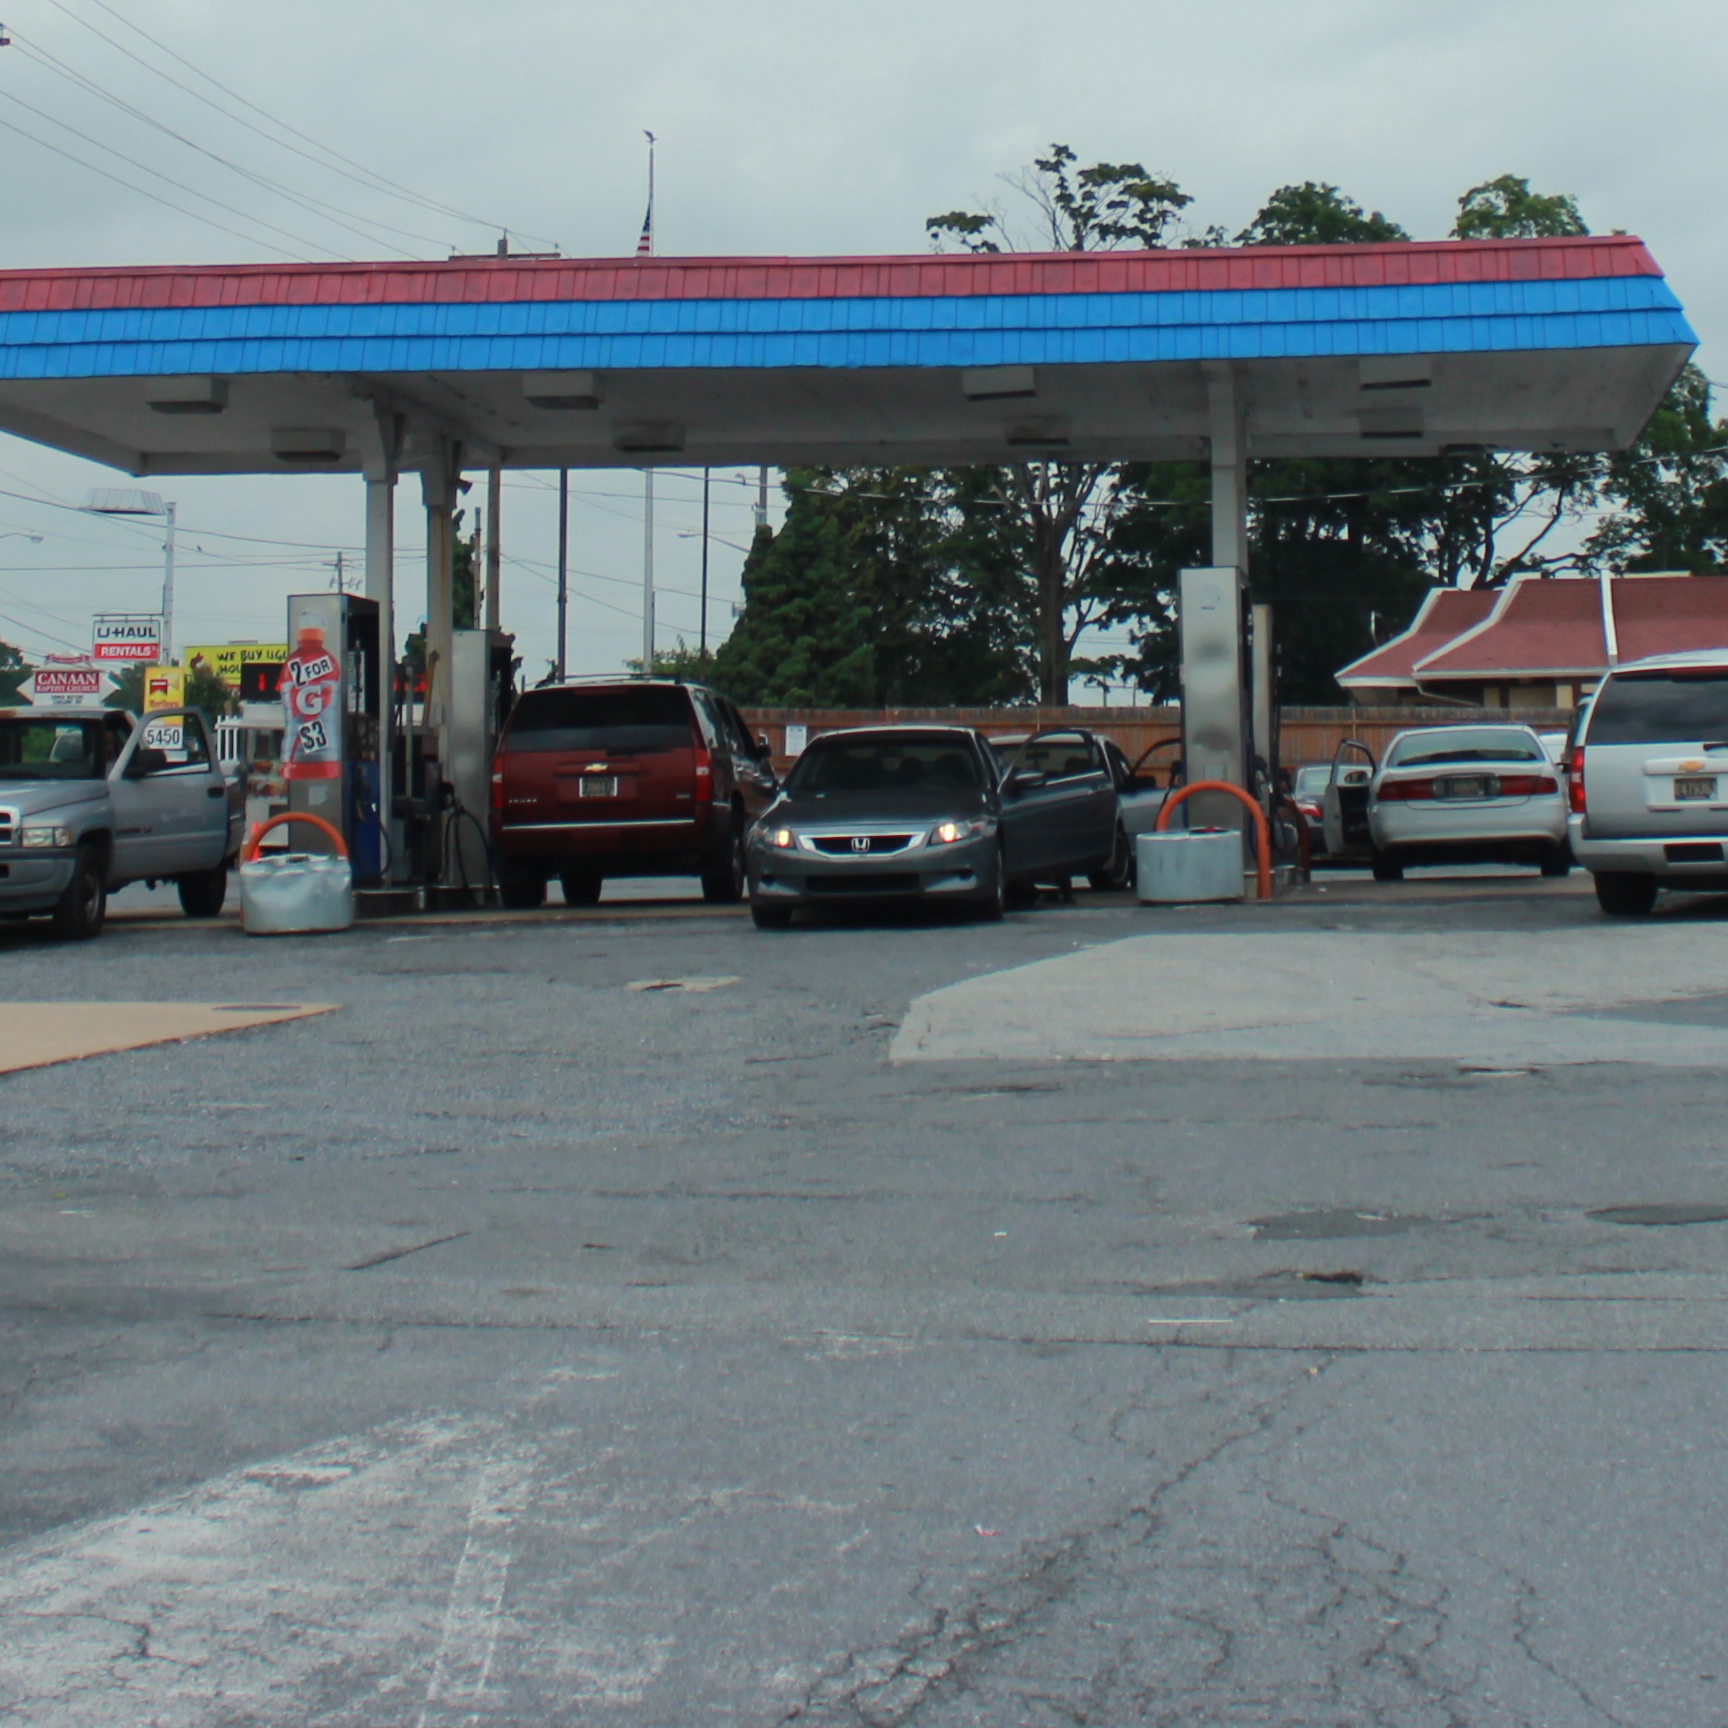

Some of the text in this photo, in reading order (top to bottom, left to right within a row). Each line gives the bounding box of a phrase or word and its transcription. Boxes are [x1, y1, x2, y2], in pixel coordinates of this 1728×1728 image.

[97, 626, 157, 639] U-HAUL
[100, 646, 151, 657] RENTALS
[217, 652, 236, 661] WE
[241, 650, 263, 662] BUY
[37, 672, 97, 685] CANAAN
[290, 661, 306, 688] 2
[305, 659, 330, 679] FOR
[296, 684, 323, 715] G
